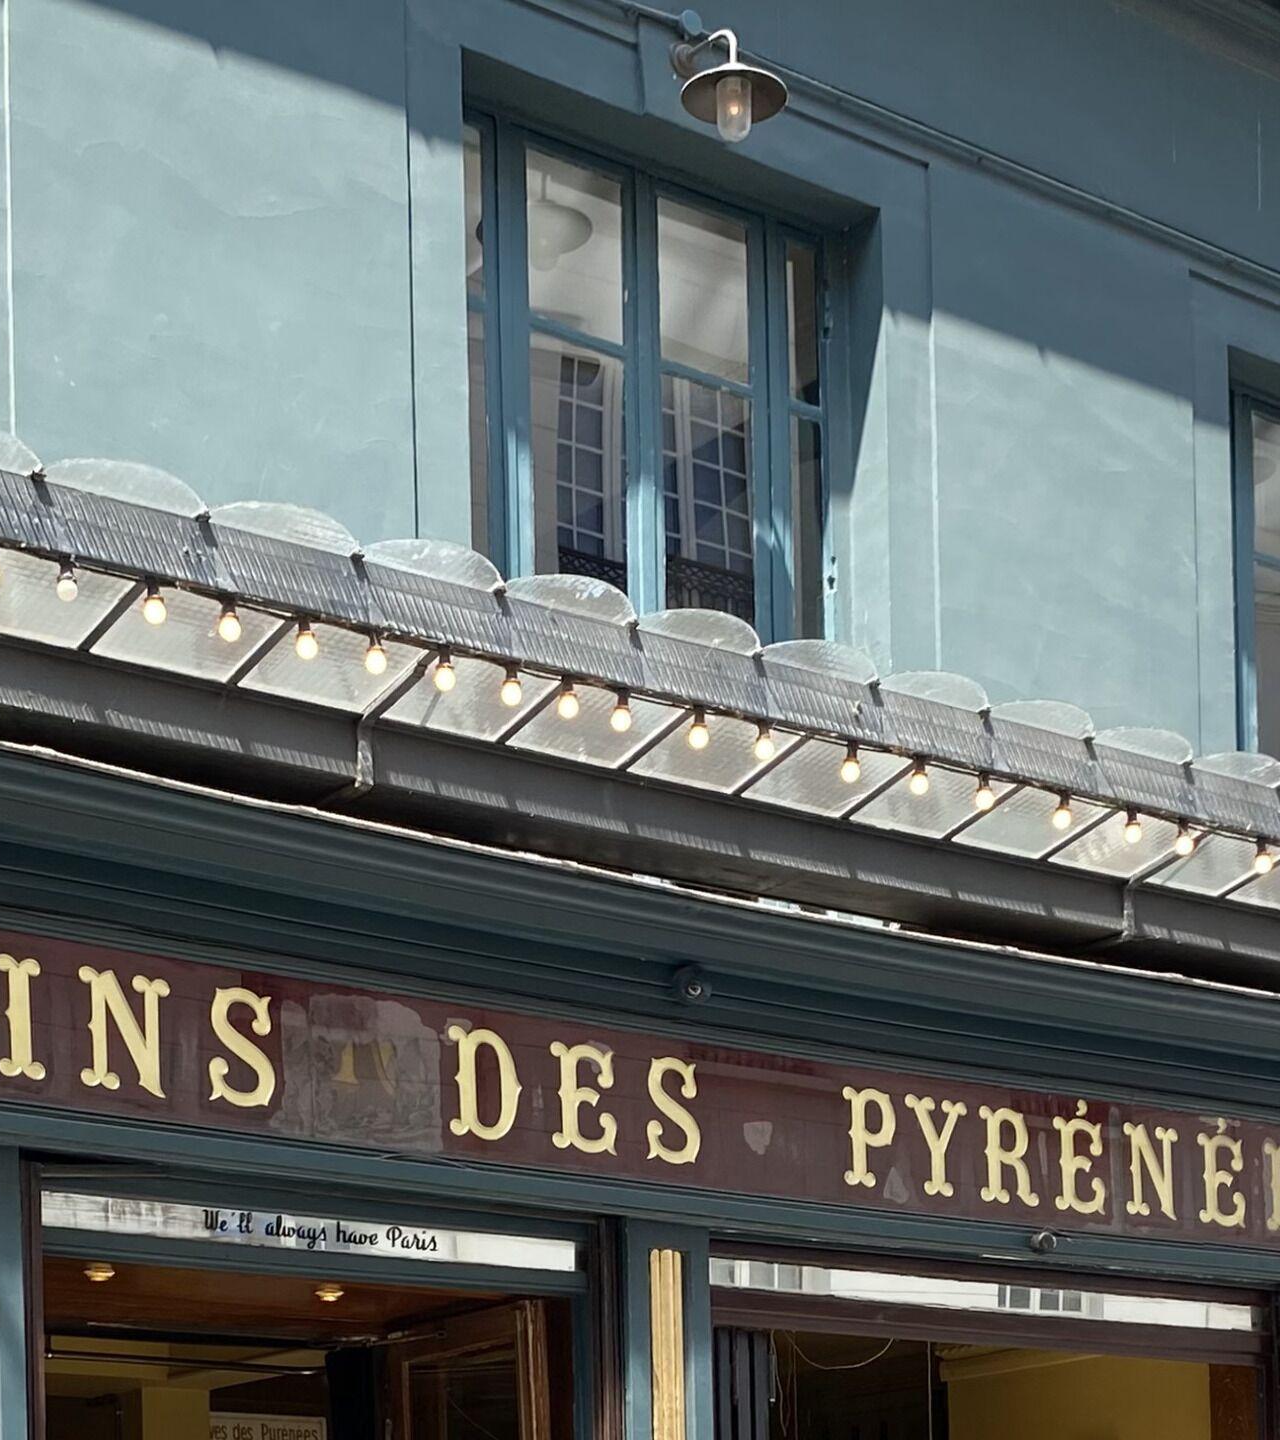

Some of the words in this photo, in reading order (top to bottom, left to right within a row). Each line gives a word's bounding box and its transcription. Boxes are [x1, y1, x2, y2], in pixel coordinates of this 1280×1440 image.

[447, 1025, 702, 1166] DES
[265, 1214, 327, 1249] always
[336, 1221, 380, 1246] have
[387, 1225, 438, 1252] Paris
